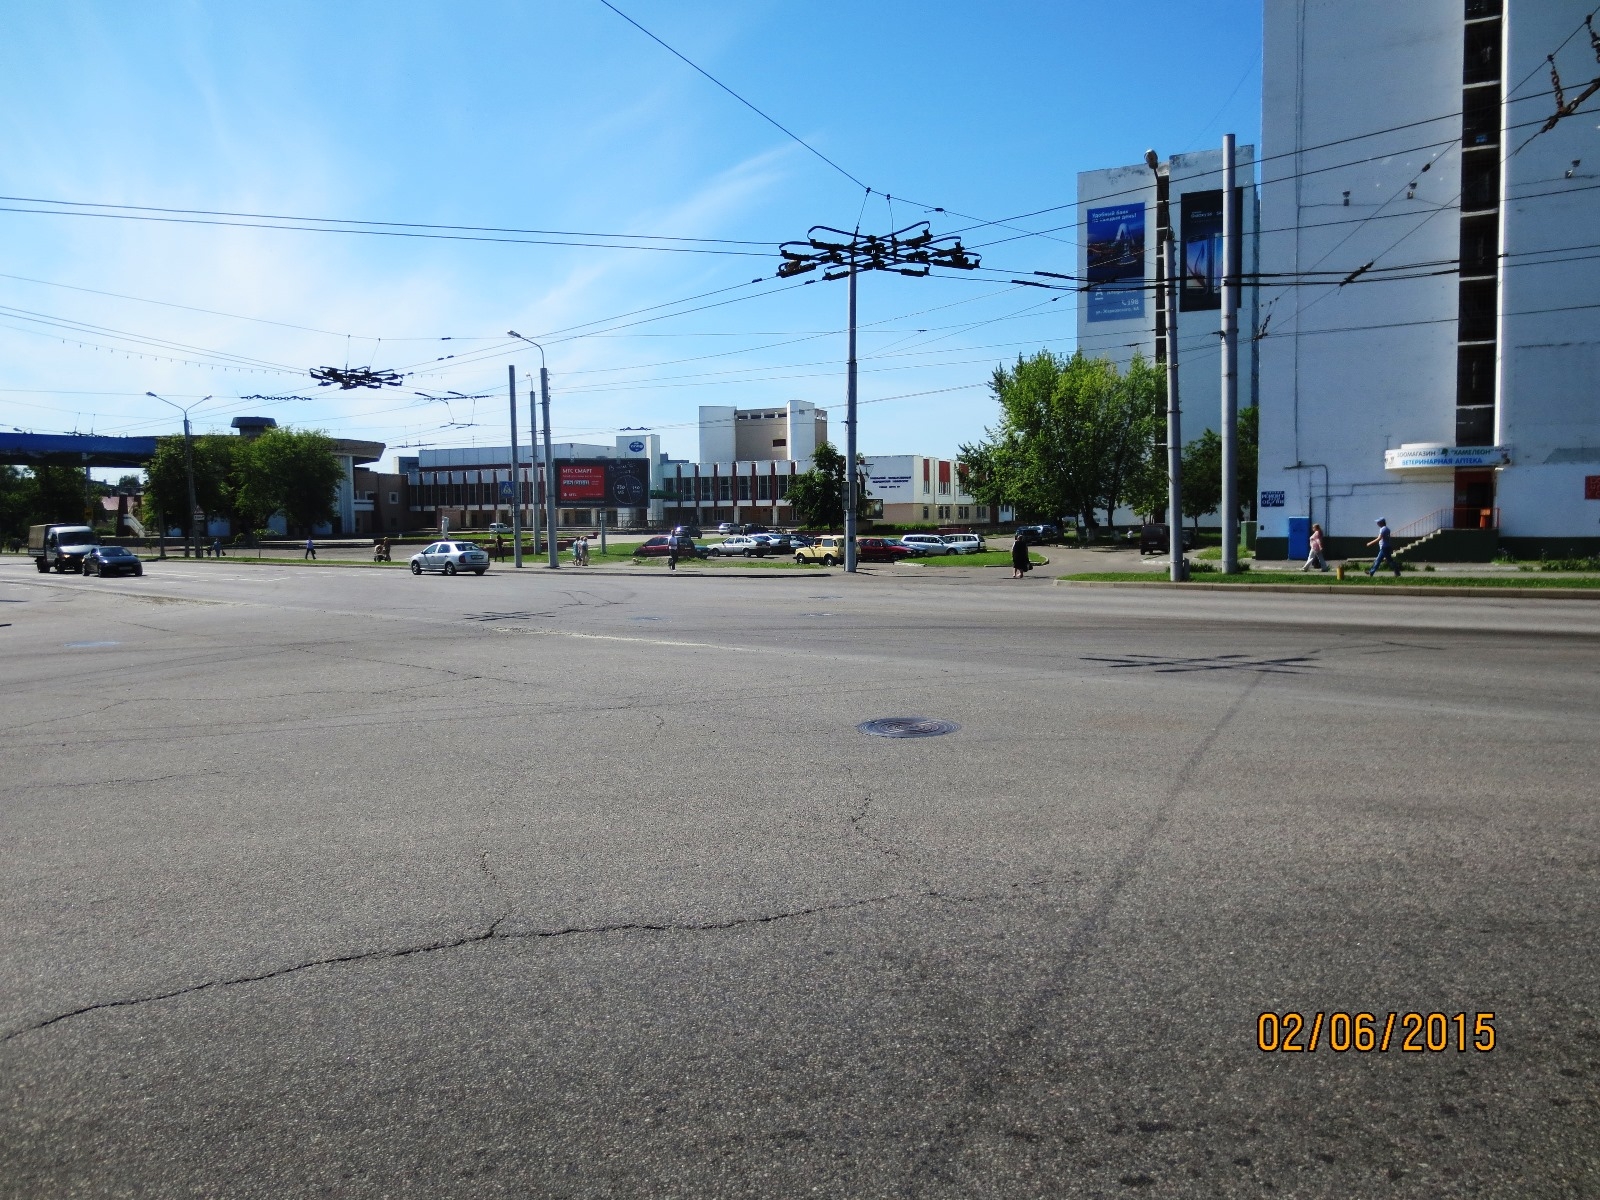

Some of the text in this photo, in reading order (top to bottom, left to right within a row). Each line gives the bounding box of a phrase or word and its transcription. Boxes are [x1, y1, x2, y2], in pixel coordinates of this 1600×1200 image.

[1092, 210, 1115, 219] Удобный
[1127, 298, 1139, 306] 198
[1401, 456, 1483, 466] ВЕТЕРИНАРНАЯ АПТЕКА
